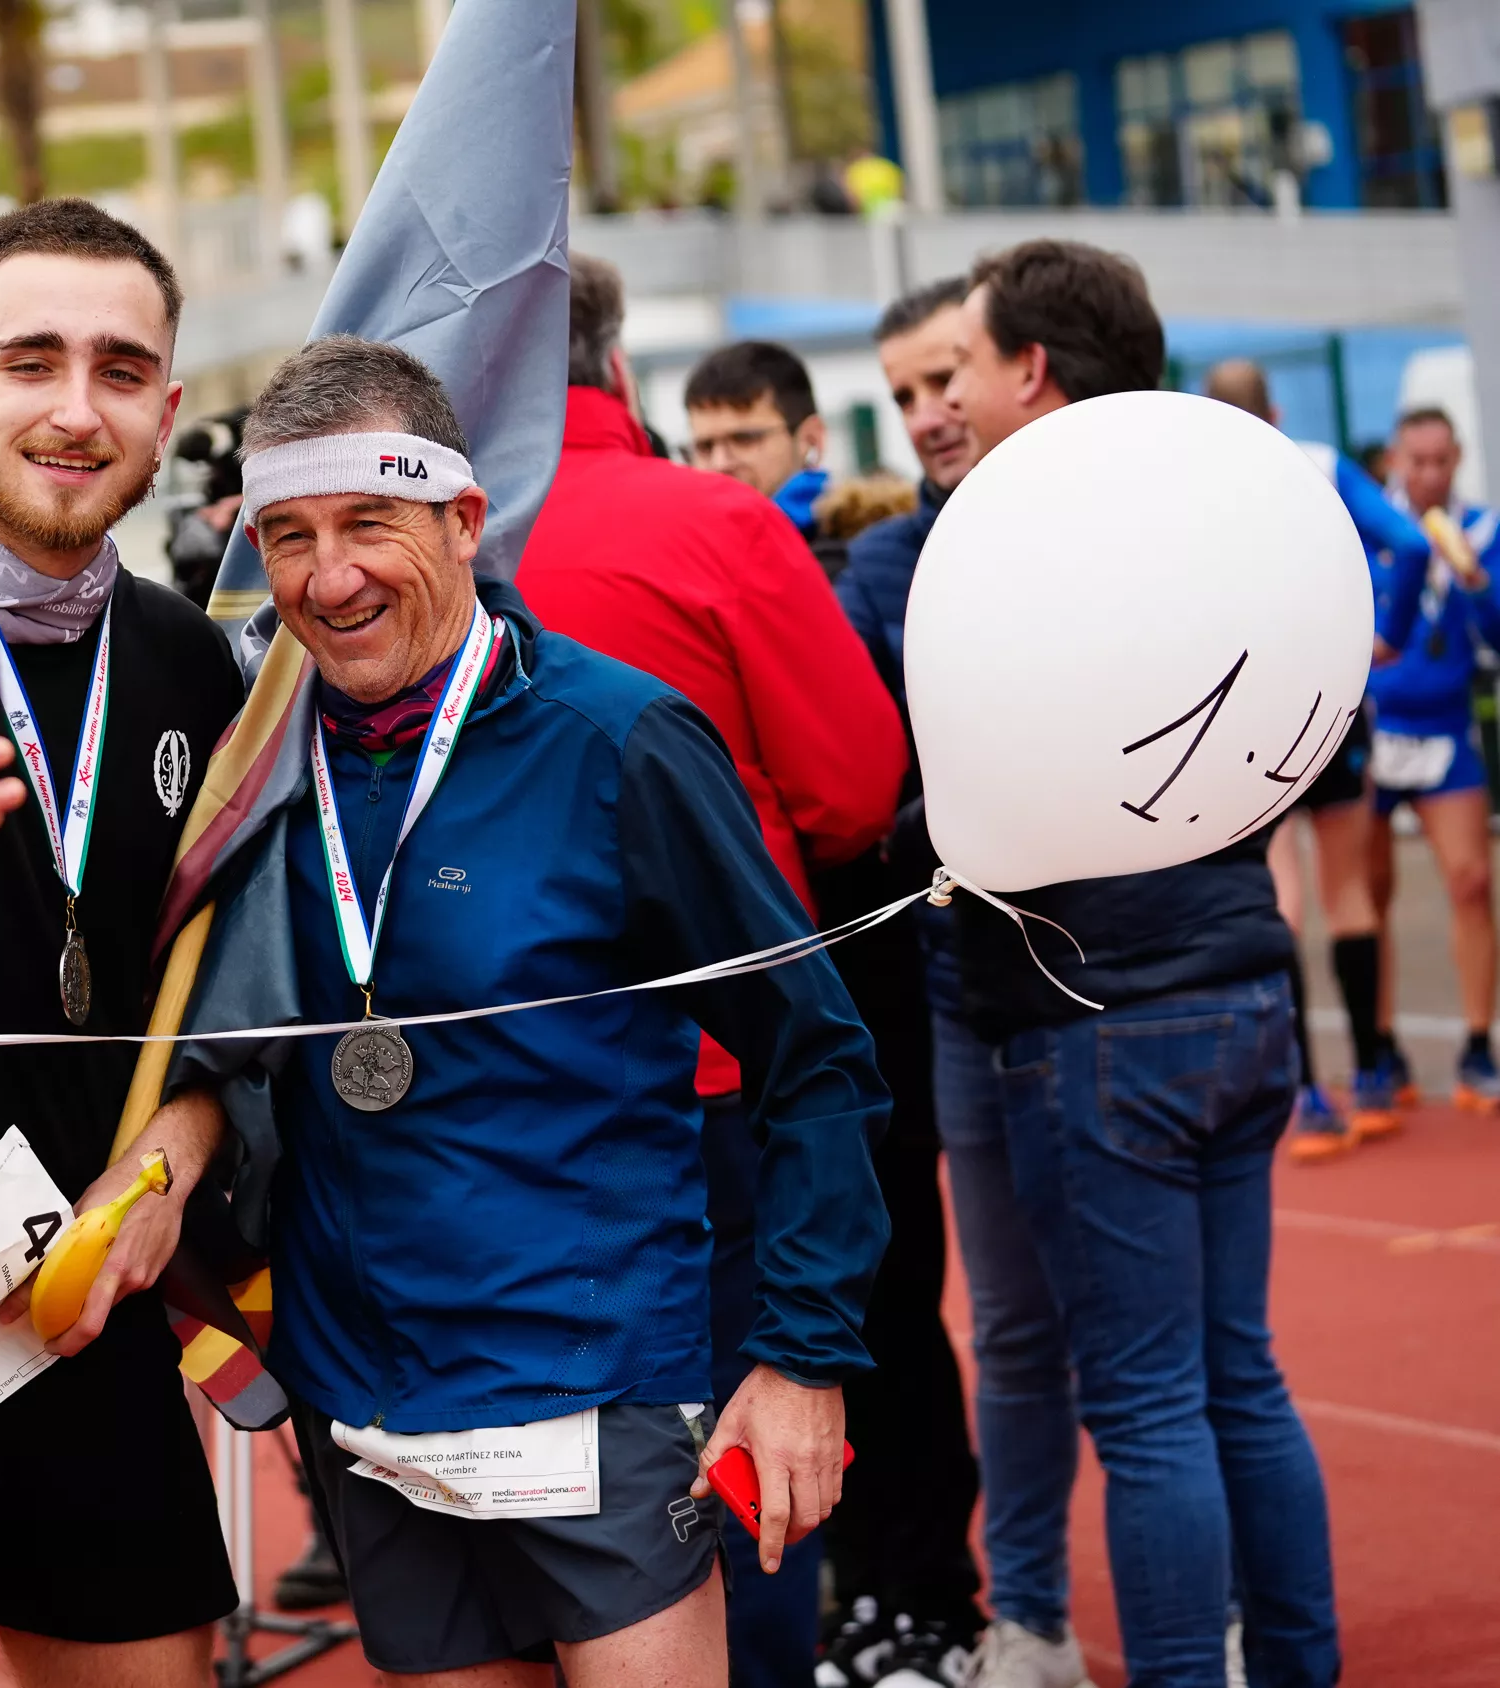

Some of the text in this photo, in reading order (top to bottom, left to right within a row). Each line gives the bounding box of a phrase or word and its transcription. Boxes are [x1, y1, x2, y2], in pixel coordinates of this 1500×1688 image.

[380, 455, 428, 480] FILA
[41, 603, 89, 617] Mobility
[334, 871, 355, 903] 2024
[428, 878, 471, 895] Kalenji
[0, 1373, 20, 1389] TIEMPO
[397, 1449, 523, 1464] FRANCISCO MARTÍNEZ REINA
[435, 1466, 477, 1475] L-Hombre
[492, 1485, 587, 1497] mediamaratonlucena.com
[492, 1496, 548, 1504] #mediamaratonlucena
